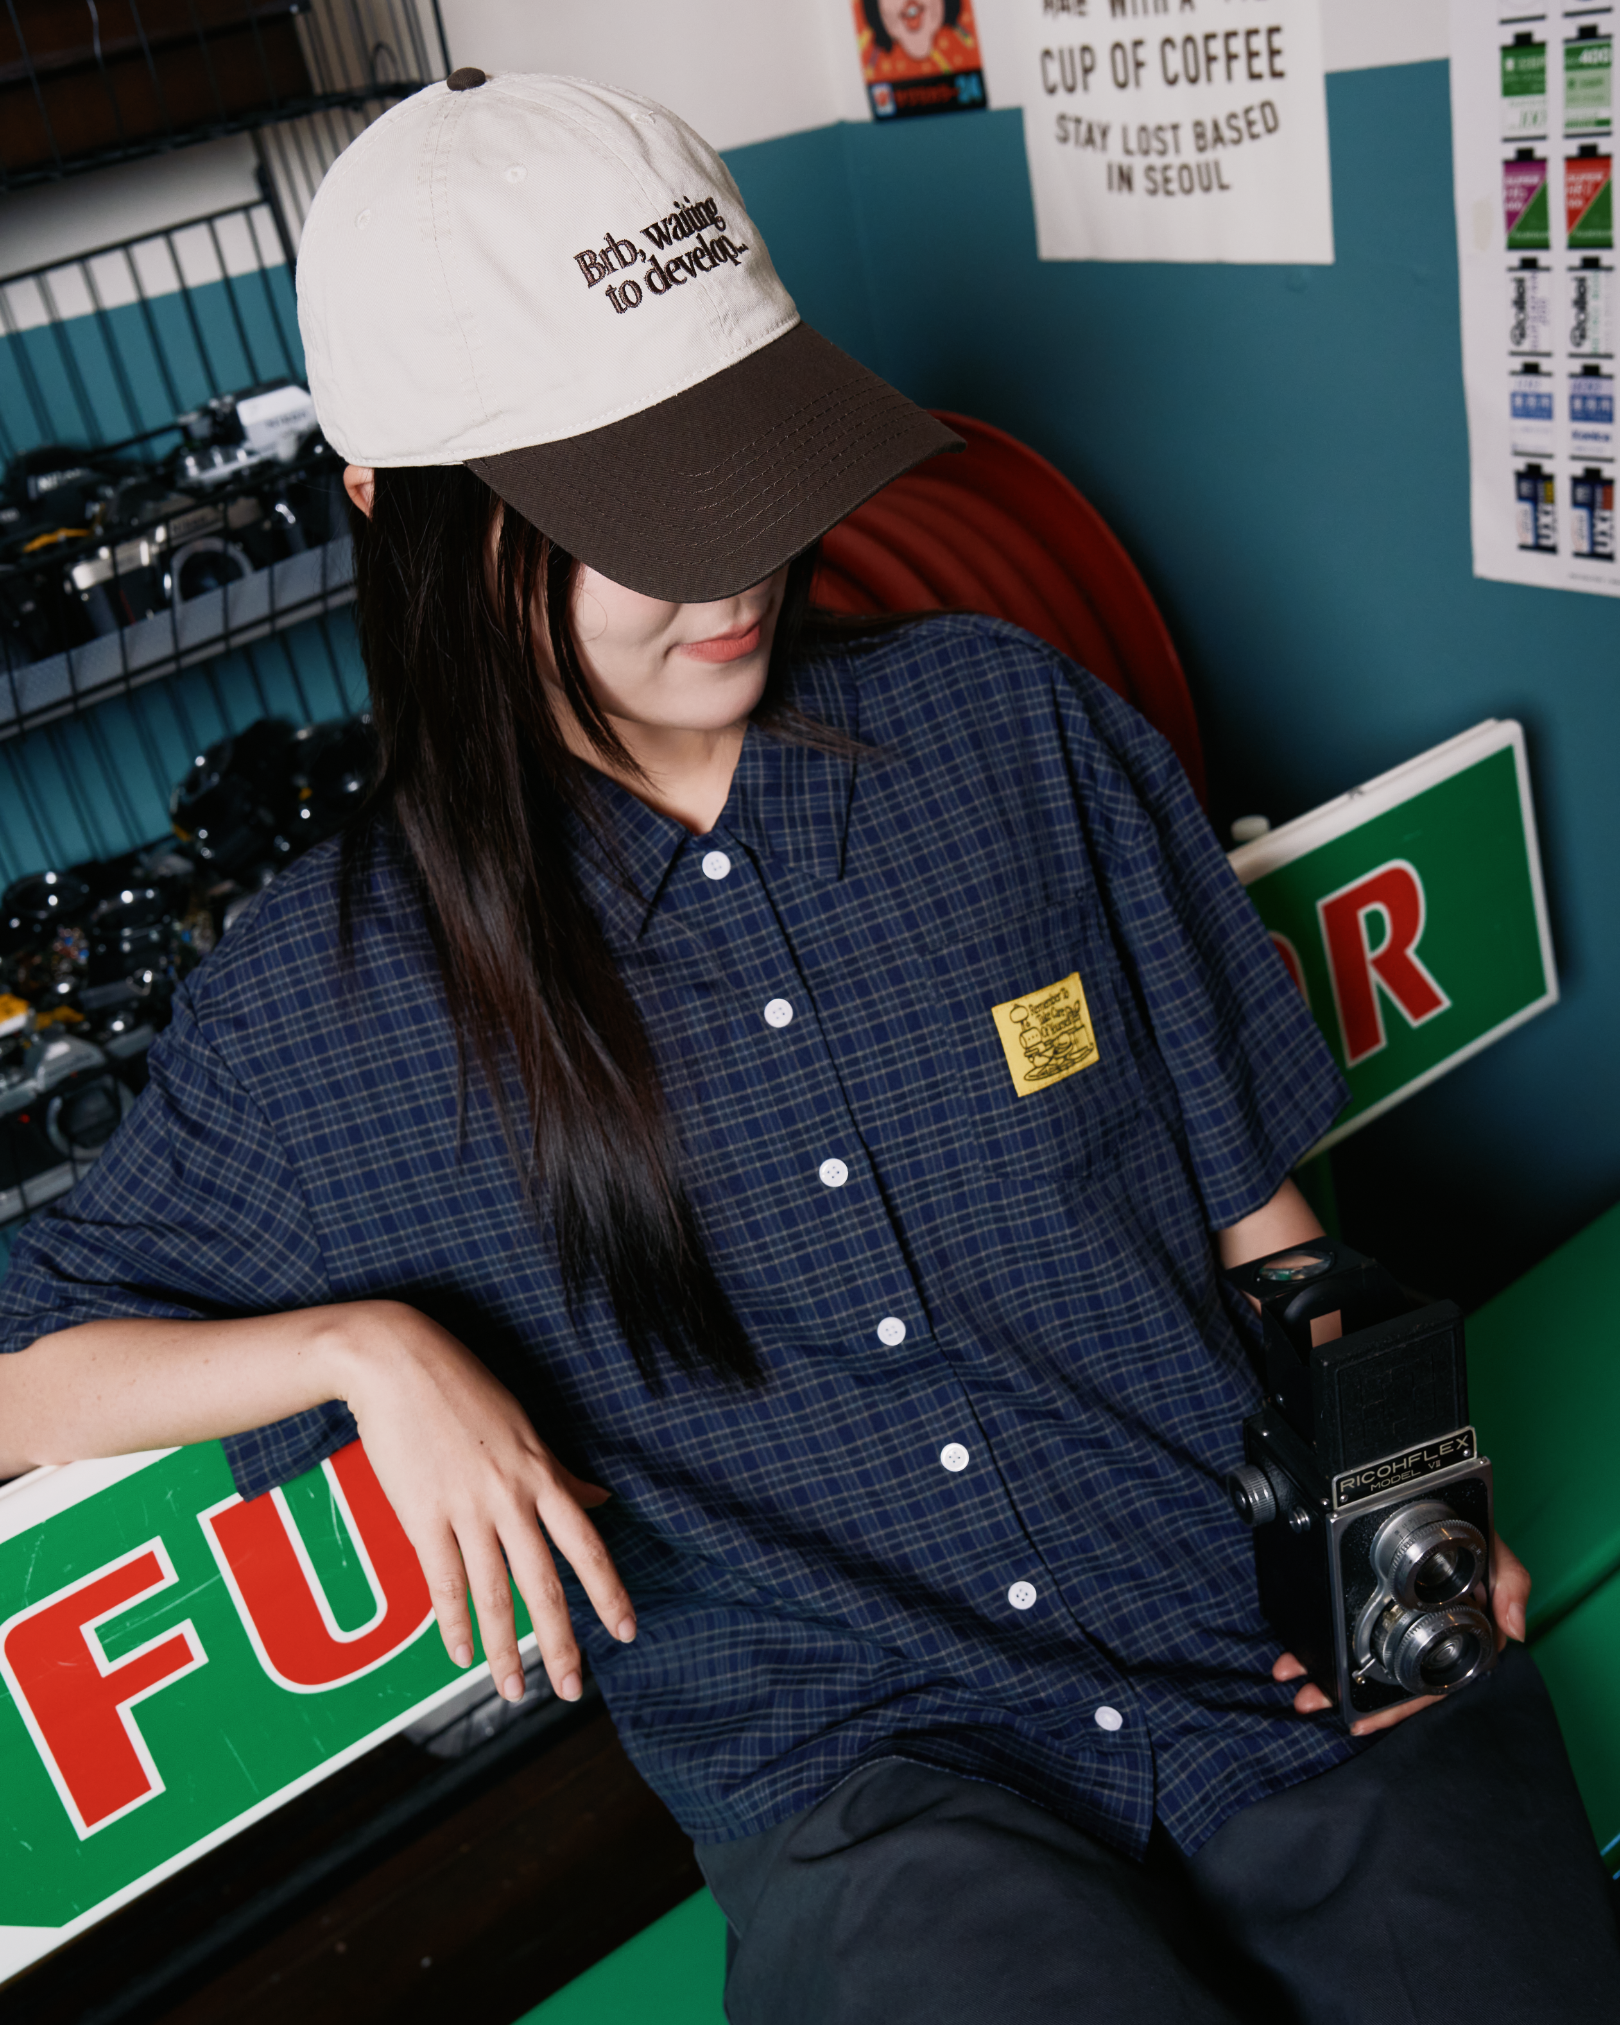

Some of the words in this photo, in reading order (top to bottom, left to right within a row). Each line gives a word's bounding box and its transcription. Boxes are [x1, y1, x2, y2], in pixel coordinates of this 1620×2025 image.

[1040, 44, 1097, 95] CUP
[1110, 39, 1146, 90] OF
[1160, 24, 1286, 86] COFFEE
[1055, 112, 1111, 153] STAY
[1122, 123, 1183, 157] LOST
[1192, 99, 1281, 154] BASED
[1106, 161, 1135, 194] IN
[1144, 159, 1232, 197] SEOUL
[573, 232, 647, 289] Brb,
[640, 195, 727, 250] waiting
[605, 280, 643, 314] to
[1268, 858, 1452, 1070] R
[1340, 1435, 1469, 1493] RICOHFLEX
[1370, 1469, 1422, 1492] MODEL
